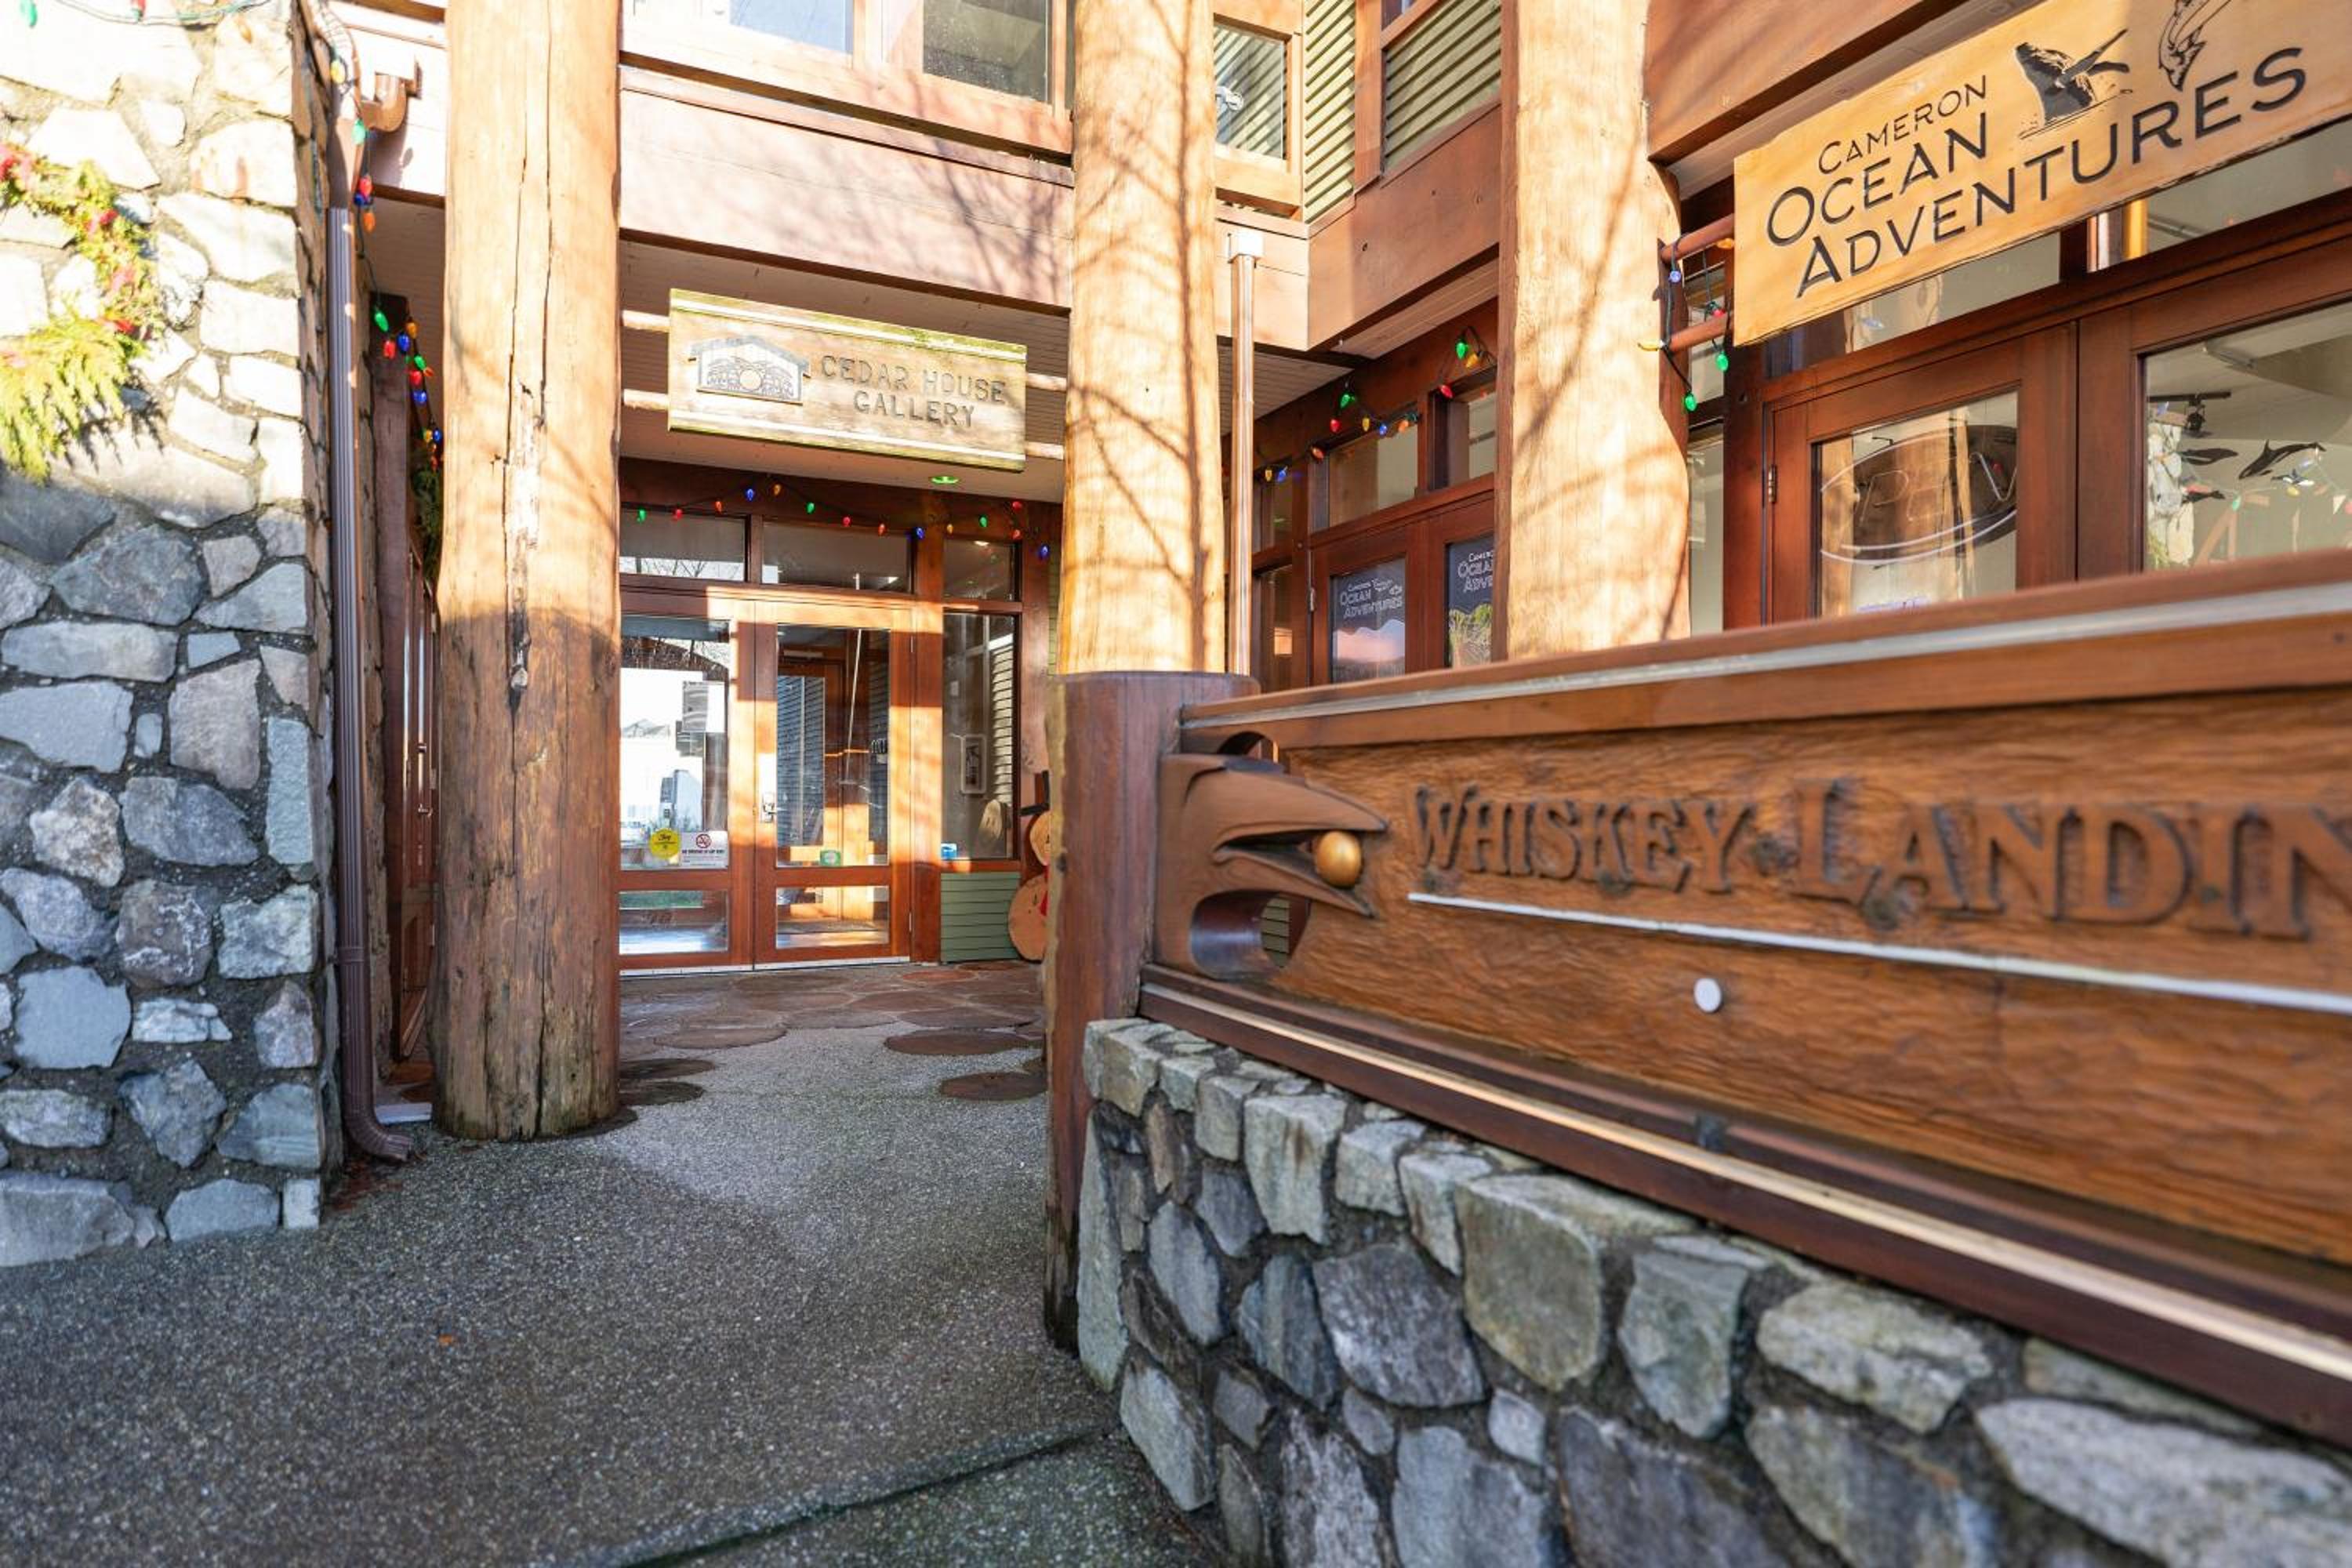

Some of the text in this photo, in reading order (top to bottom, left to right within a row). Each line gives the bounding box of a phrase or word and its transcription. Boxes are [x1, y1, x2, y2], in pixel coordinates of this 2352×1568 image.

[1795, 46, 2307, 299] ADVENTURES
[1817, 74, 1987, 176] CAMERON
[1766, 111, 1988, 248] OCEAN
[822, 354, 1007, 405] CEDAR HOUSE
[853, 390, 975, 428] GALLERY
[1340, 589, 1371, 607] OCEAN
[1415, 782, 1756, 895] WHISKEY
